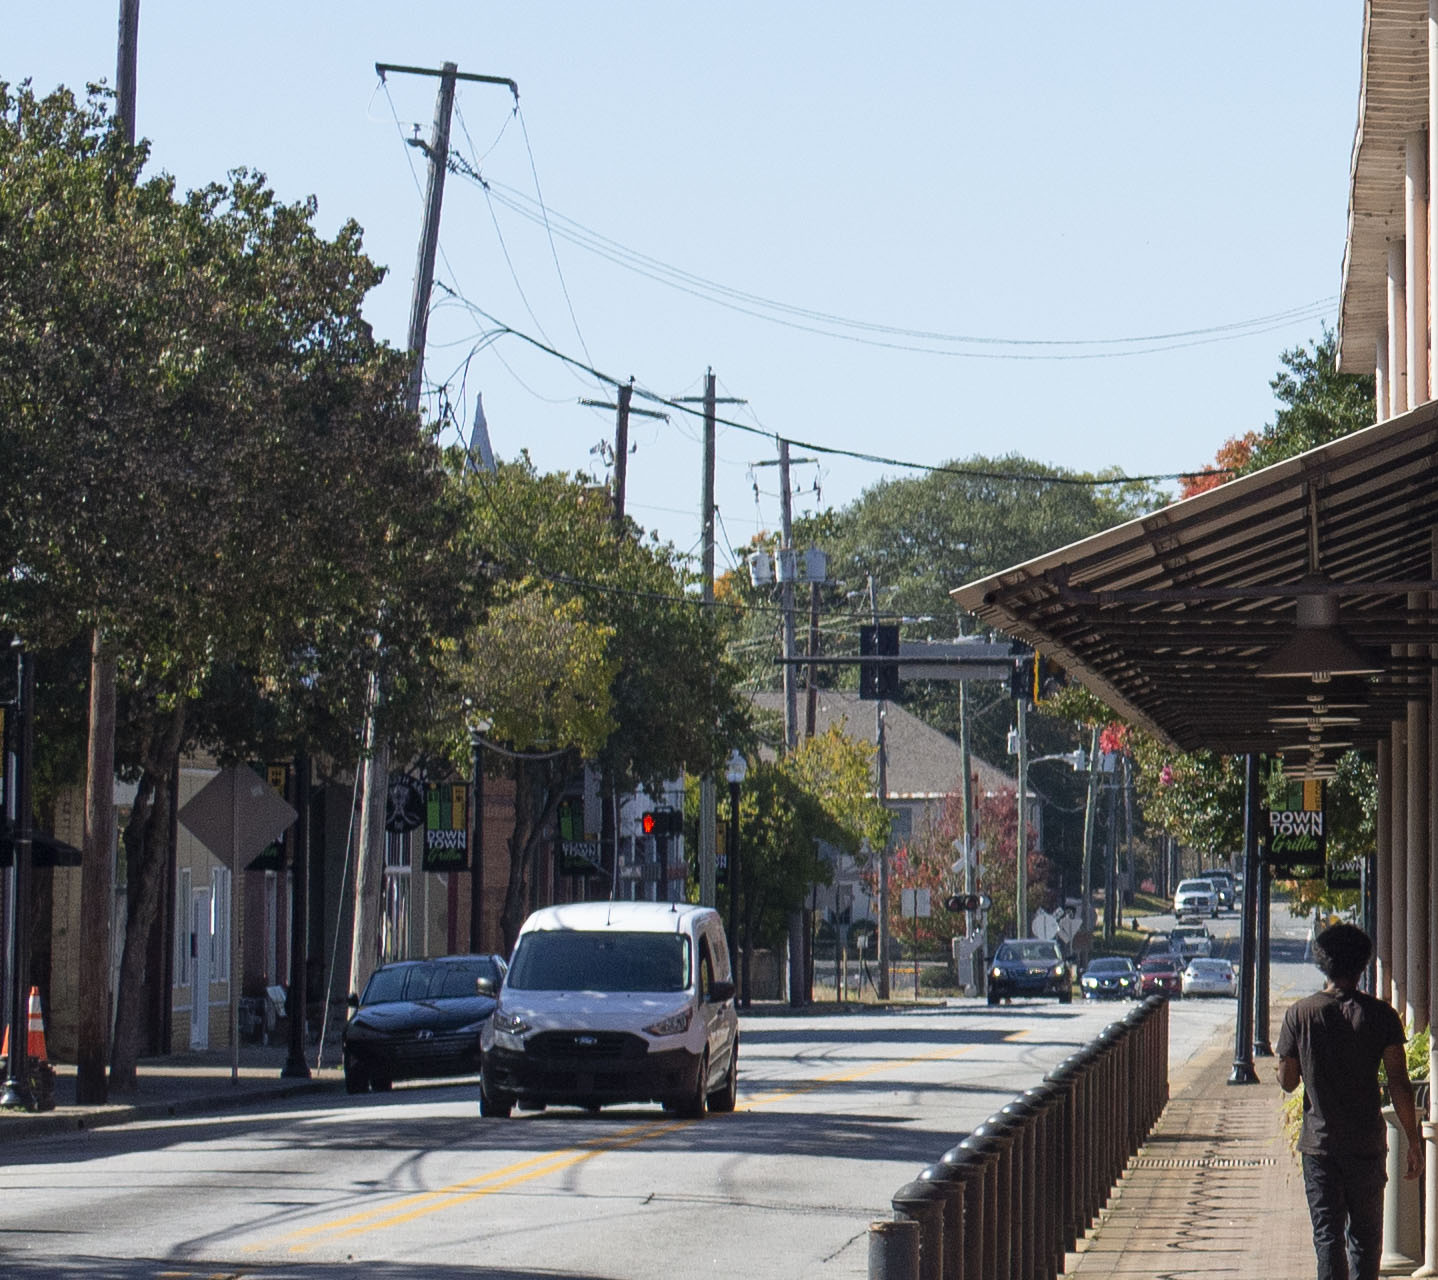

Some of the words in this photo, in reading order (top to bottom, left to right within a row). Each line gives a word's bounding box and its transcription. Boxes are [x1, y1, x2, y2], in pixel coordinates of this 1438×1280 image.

[1269, 811, 1323, 824] DOWN
[427, 829, 466, 840] DOWN
[1271, 823, 1323, 836] TOWN
[428, 839, 466, 849] TOWN
